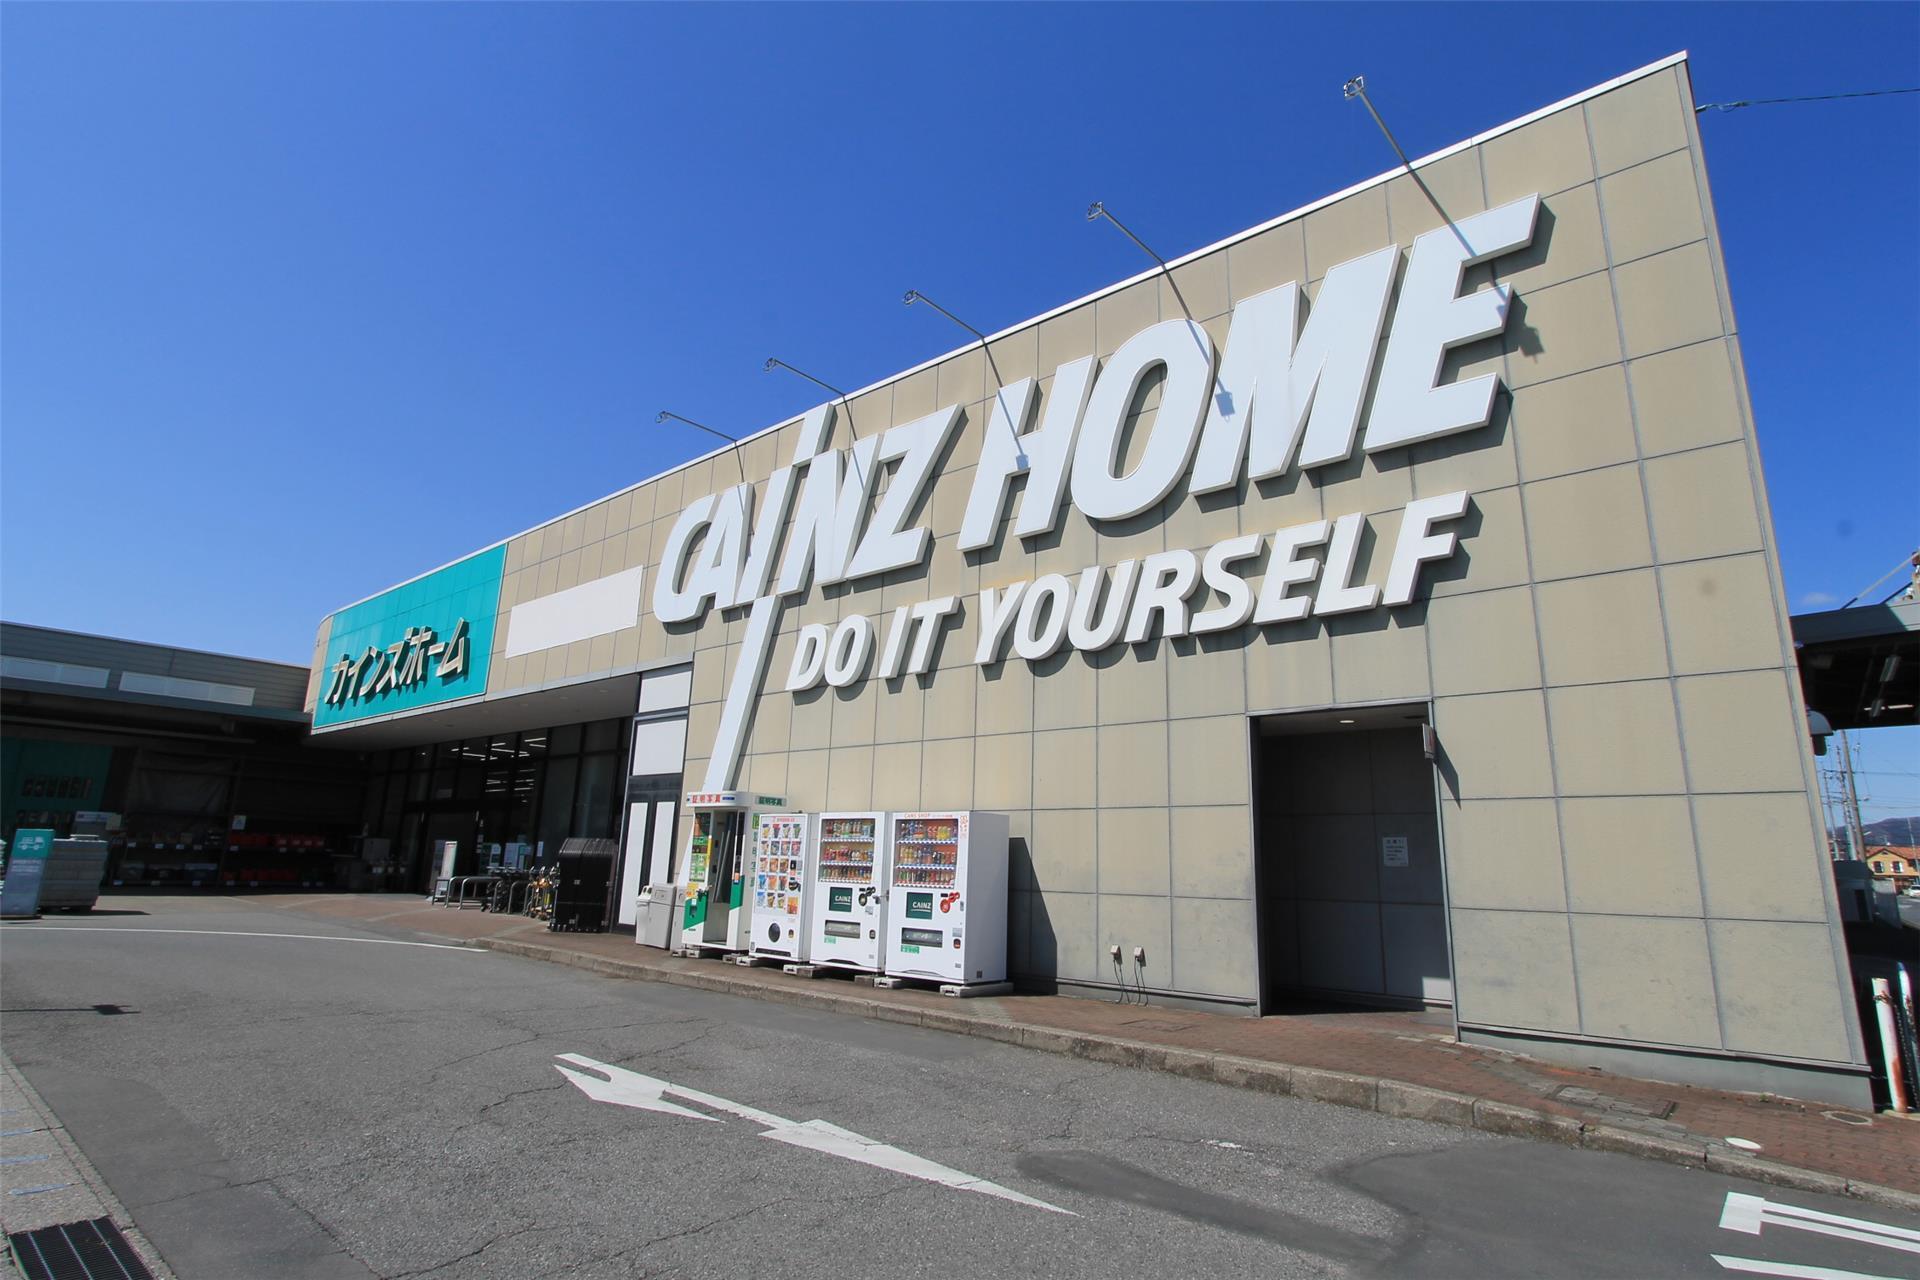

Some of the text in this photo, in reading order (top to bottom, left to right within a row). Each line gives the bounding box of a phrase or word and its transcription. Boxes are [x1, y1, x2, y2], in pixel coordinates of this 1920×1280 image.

[652, 193, 1541, 625] CAINZ HOME
[324, 617, 469, 705] カインズホーム
[785, 489, 1471, 693] DO IT YOURSELF
